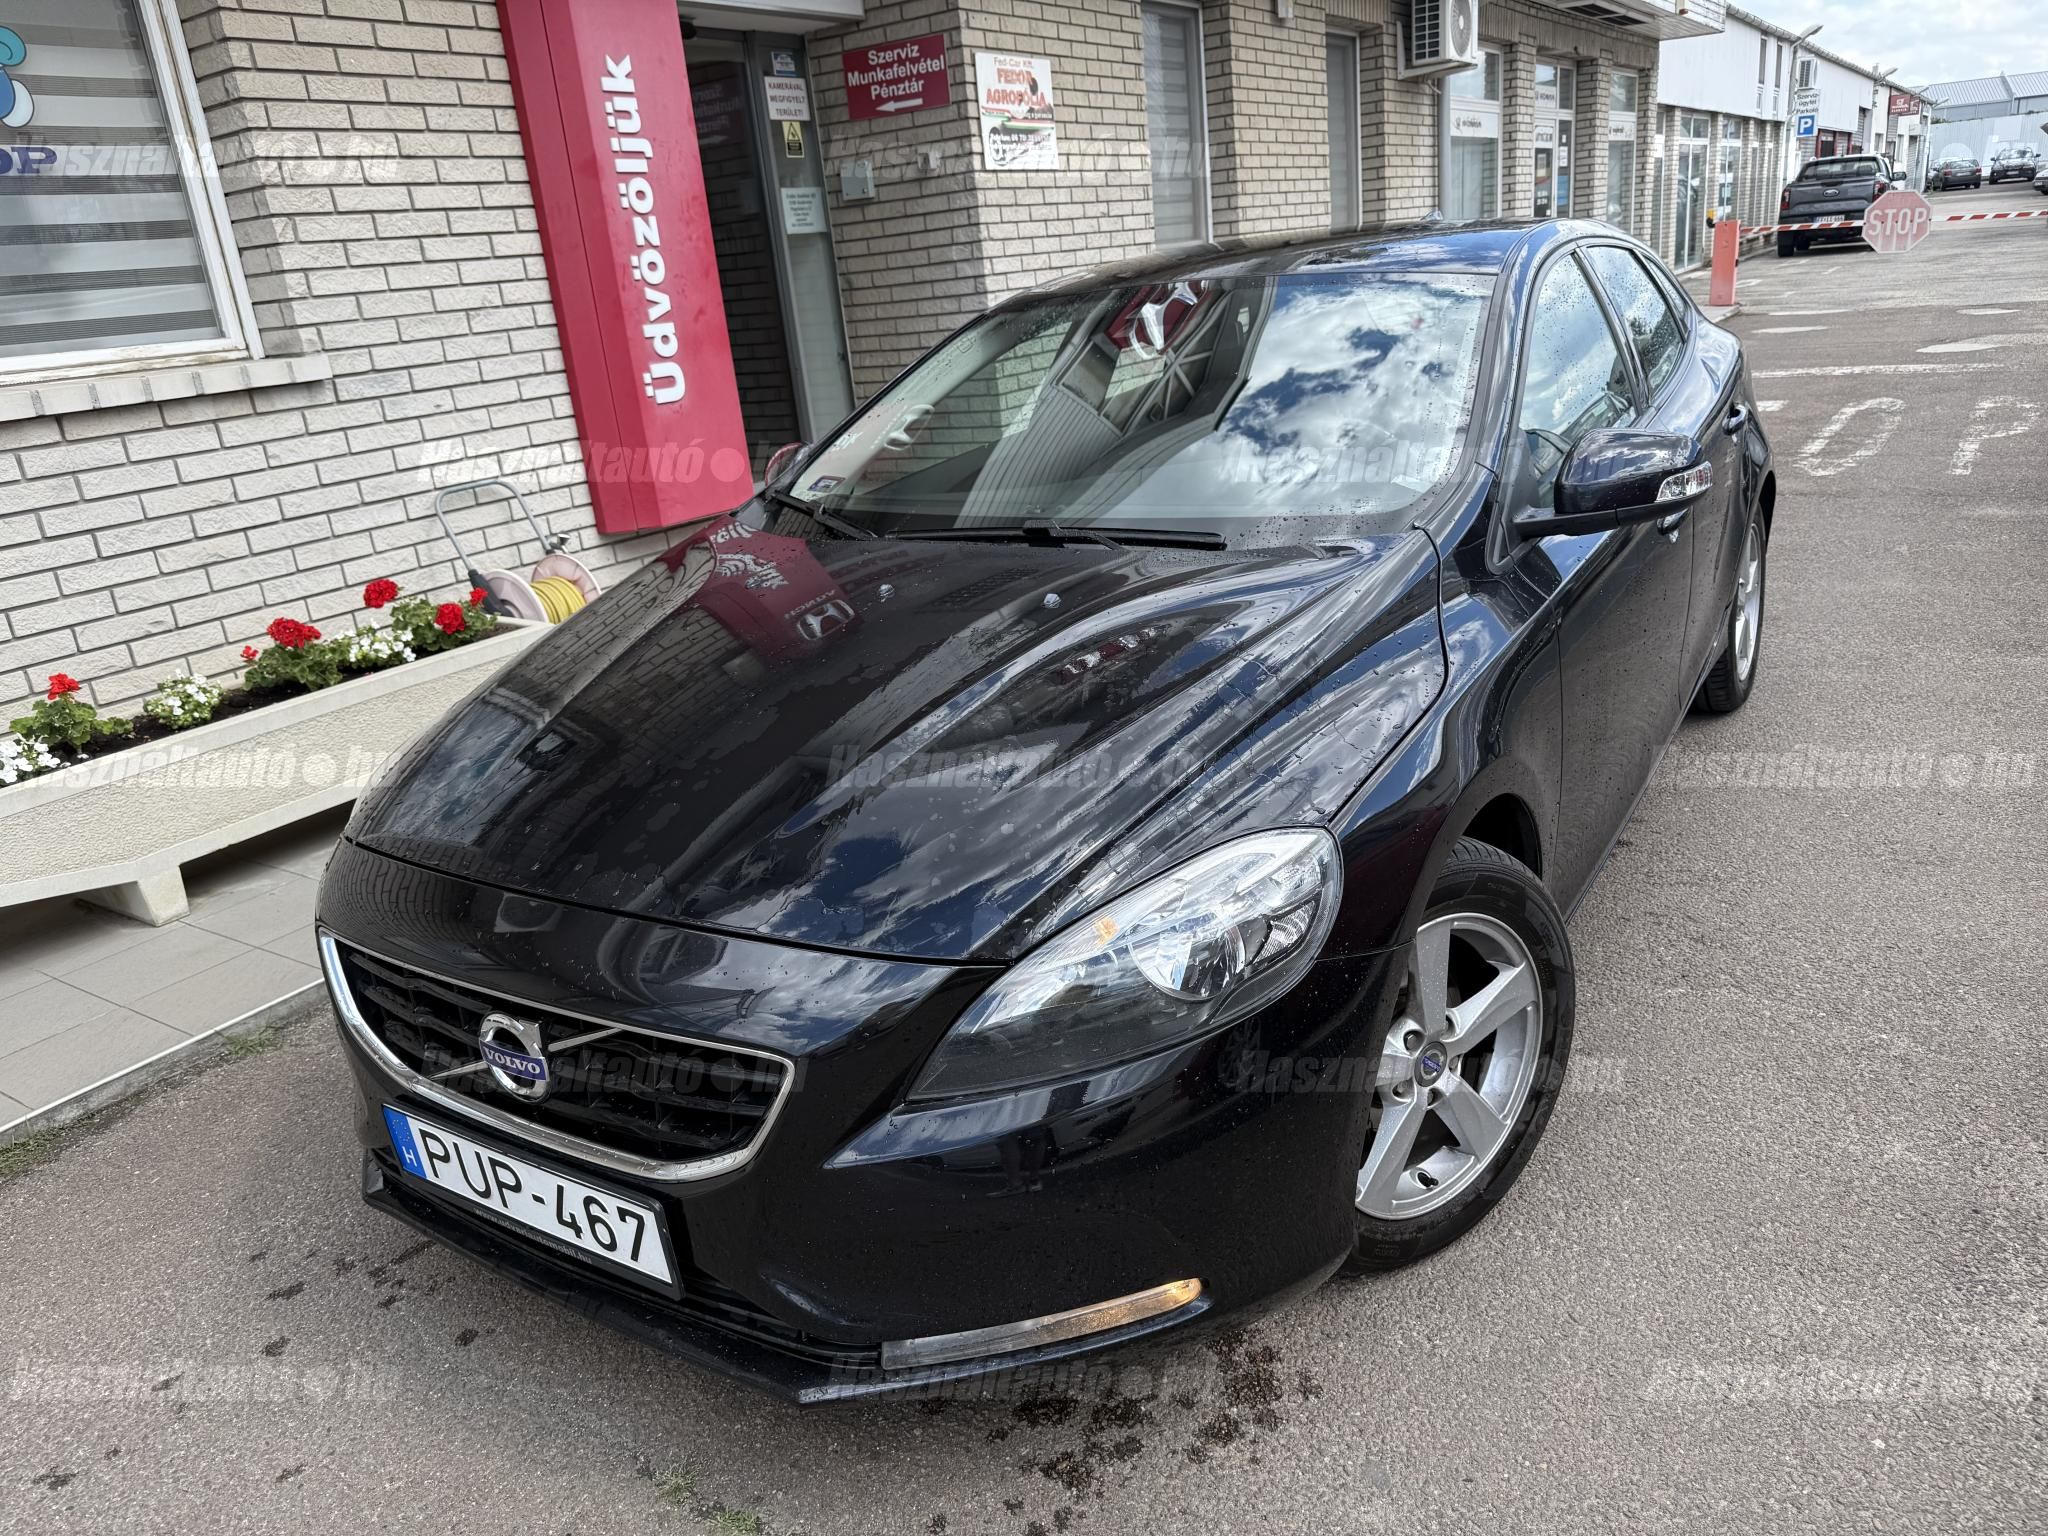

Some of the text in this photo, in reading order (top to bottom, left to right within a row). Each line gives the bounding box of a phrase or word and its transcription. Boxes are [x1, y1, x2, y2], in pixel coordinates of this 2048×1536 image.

[868, 43, 920, 65] Szerviz
[847, 54, 945, 87] Munkafelvétel
[871, 77, 924, 100] Pénztár
[1800, 118, 1813, 133] P
[600, 53, 686, 405] Üdvözöljük
[1868, 207, 1928, 237] STOP
[483, 1047, 542, 1076] VOLVO
[402, 1146, 417, 1168] H
[418, 1127, 646, 1262] PUP-467
